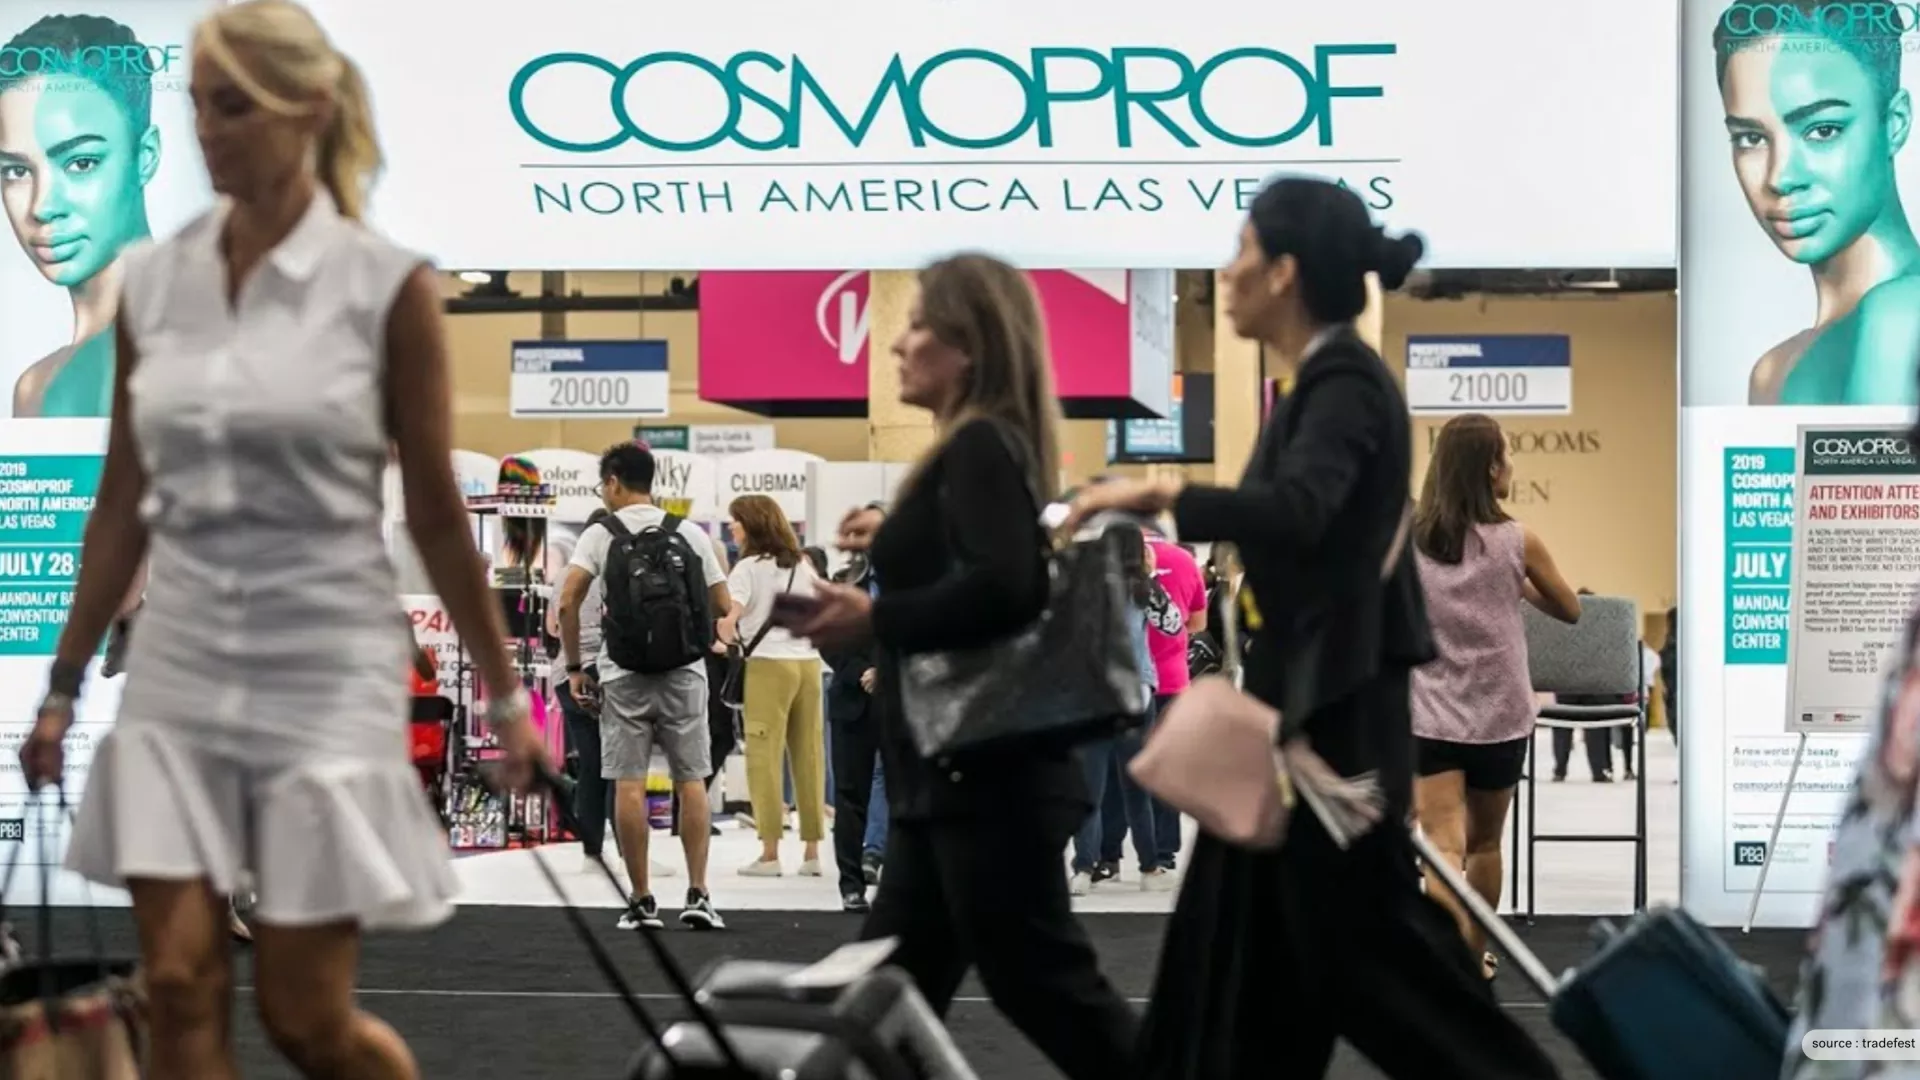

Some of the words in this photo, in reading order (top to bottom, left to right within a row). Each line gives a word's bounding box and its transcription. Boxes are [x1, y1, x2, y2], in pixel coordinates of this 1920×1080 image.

[509, 44, 1397, 152] COSMOPROF
[533, 179, 733, 214] NORTH
[759, 178, 1039, 213] AMERICA
[1064, 178, 1164, 212] LAS
[1187, 176, 1395, 211] VES
[549, 377, 630, 406] 20000
[1449, 373, 1528, 402] 21000
[1731, 454, 1765, 470] 2019
[543, 466, 581, 480] olor
[1732, 492, 1778, 509] NORTH
[1809, 485, 1883, 500] ATTENTION
[1732, 511, 1756, 527] LAS
[1808, 505, 1837, 520] AND
[1841, 505, 1919, 520] EXHIBITORS
[20, 514, 56, 529] VEGAS
[48, 553, 74, 576] 28
[1732, 552, 1786, 579] JULY
[61, 591, 77, 606] BA
[1732, 633, 1781, 649] CENTER
